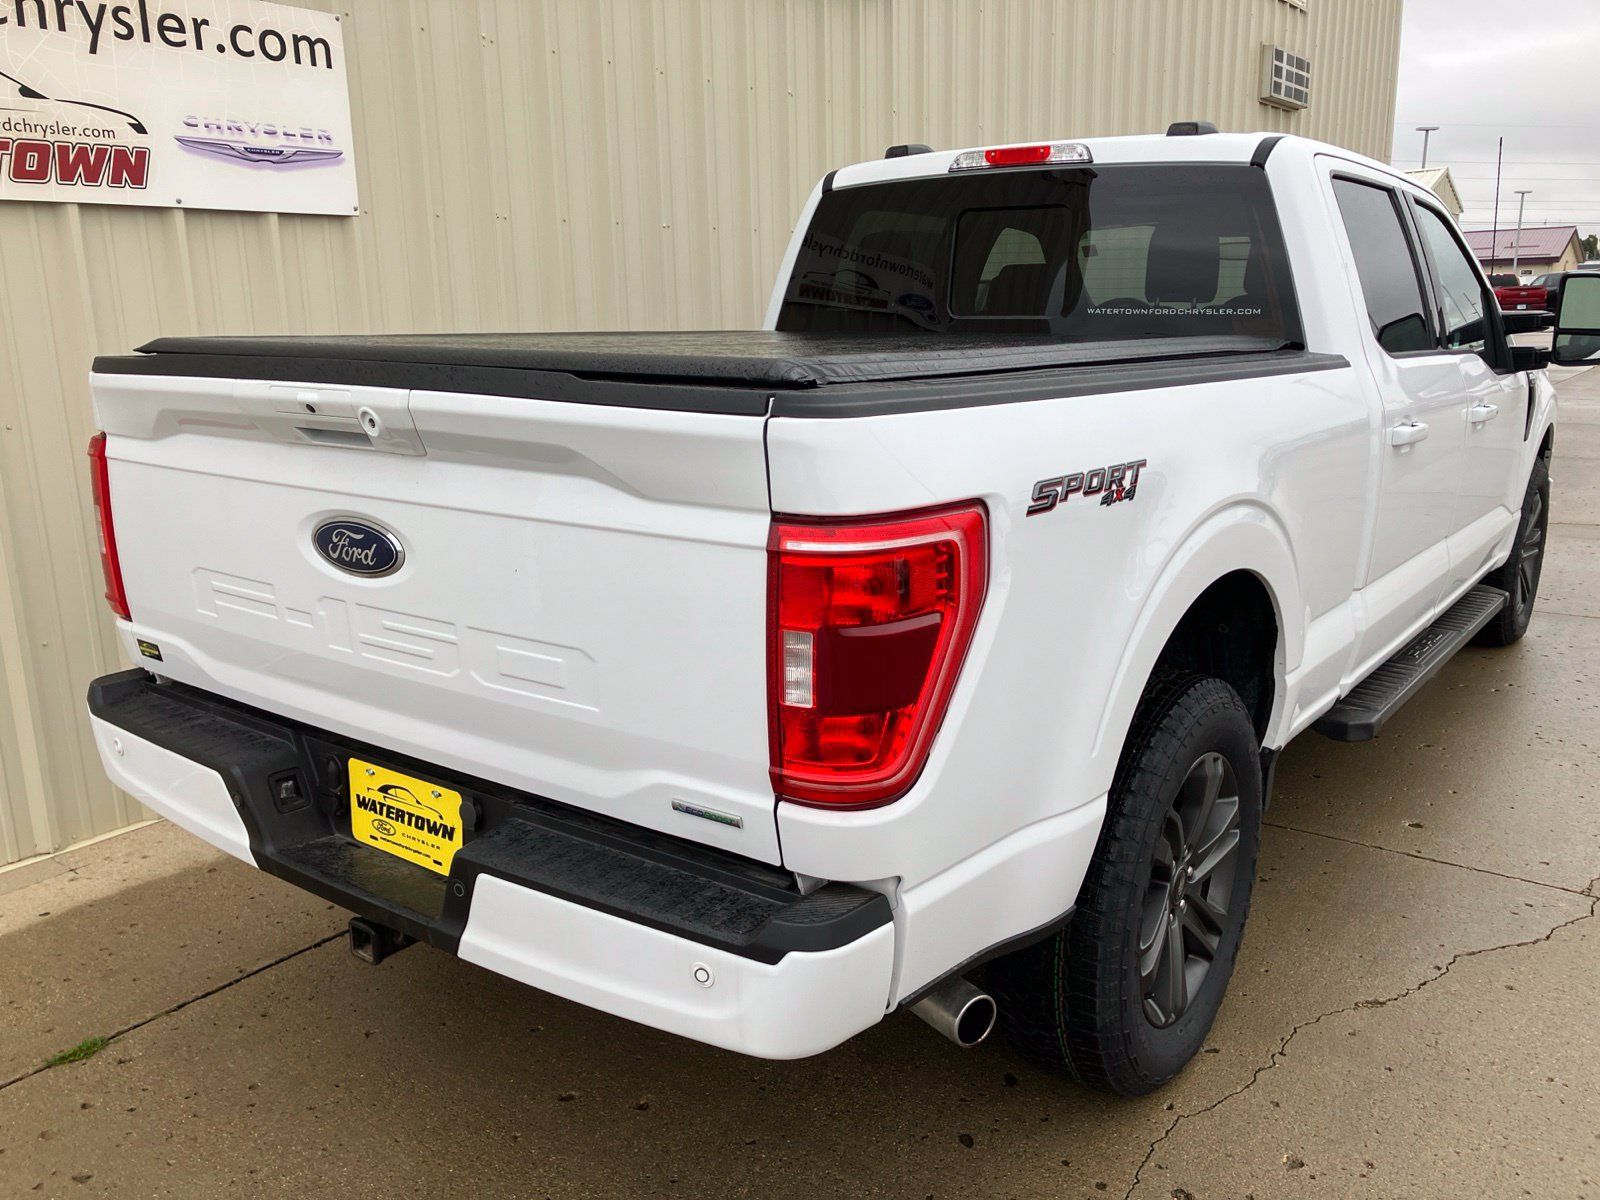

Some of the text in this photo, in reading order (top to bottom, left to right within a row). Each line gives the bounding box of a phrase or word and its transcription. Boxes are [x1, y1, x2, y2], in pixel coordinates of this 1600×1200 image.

[0, 0, 332, 69] hrysler.com
[0, 117, 116, 139] dchrysler.com
[183, 115, 332, 142] CHRYSLER
[1087, 307, 1262, 316] WATERTOWNFORDCHRYSLER.COM
[1026, 459, 1147, 517] SPORT
[328, 528, 377, 567] Ford
[192, 566, 601, 712] F-150
[355, 793, 457, 842] WATERTOWN
